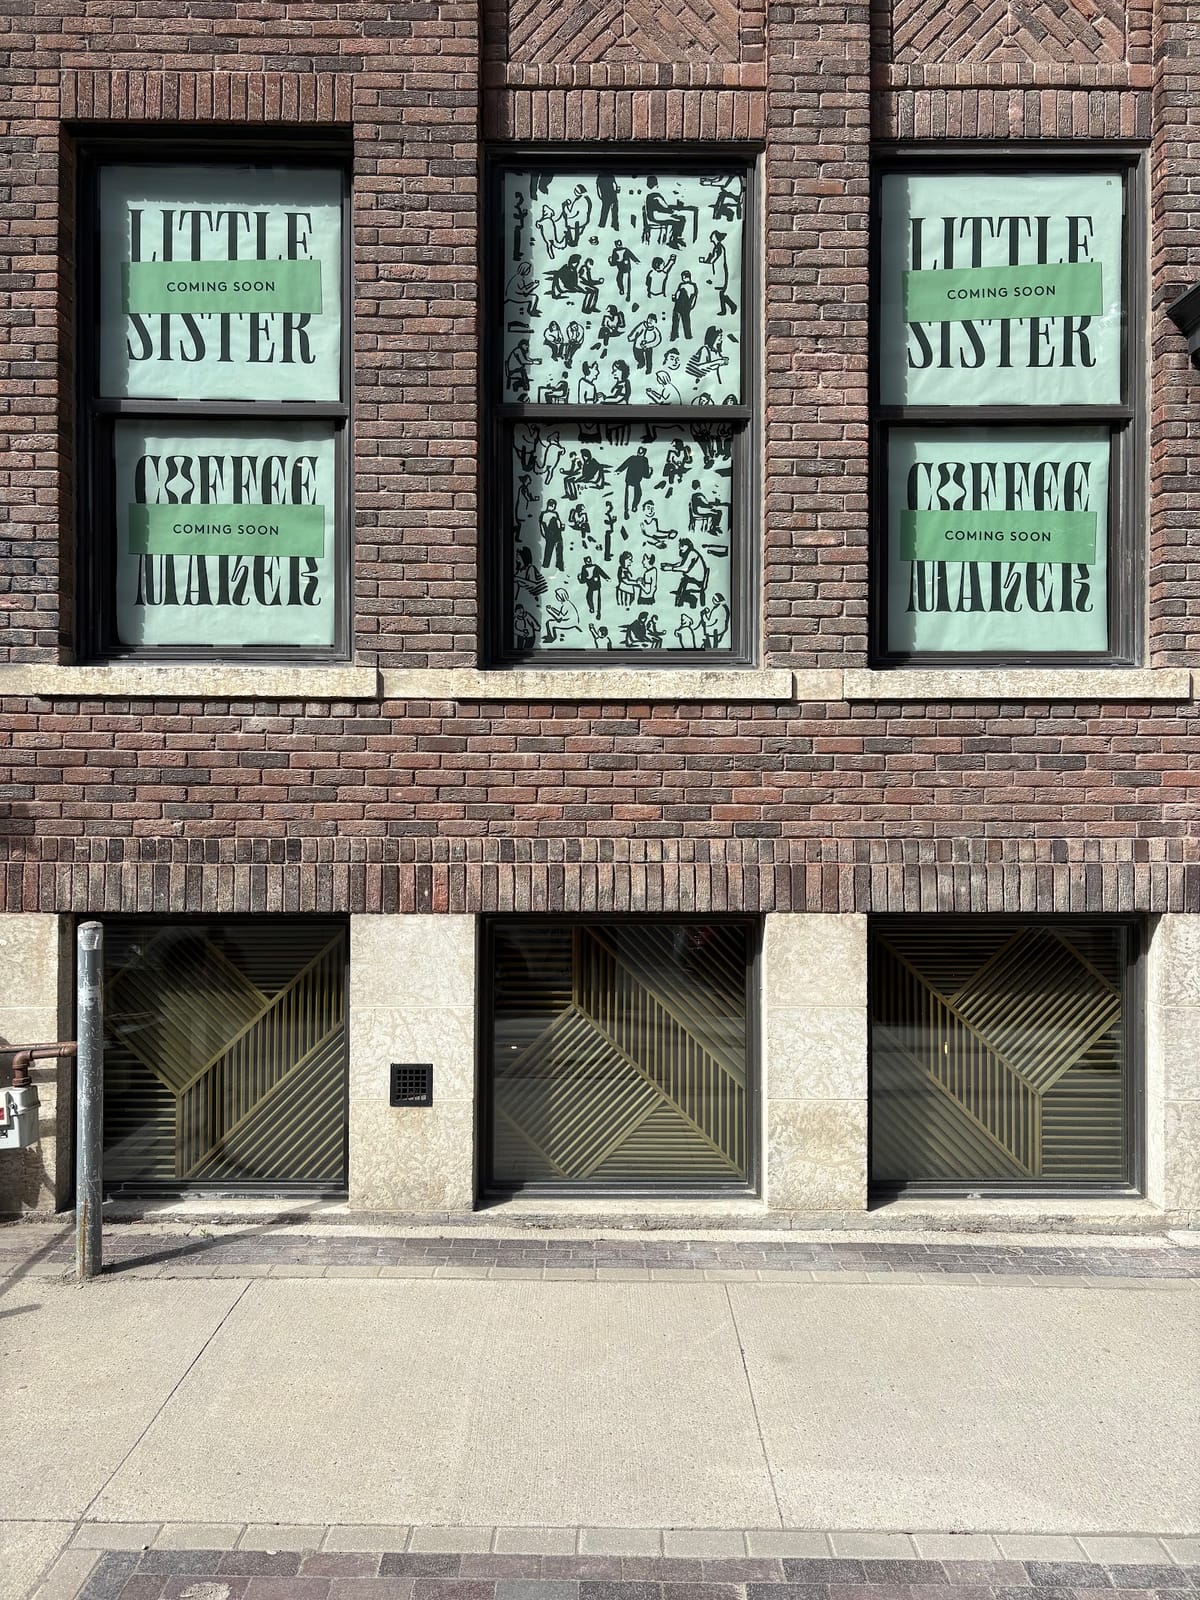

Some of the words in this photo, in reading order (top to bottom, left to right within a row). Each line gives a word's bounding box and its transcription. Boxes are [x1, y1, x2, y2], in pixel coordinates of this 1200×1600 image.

[128, 209, 313, 262] LITTLE
[909, 216, 1094, 271] LITTLE
[166, 281, 228, 292] COMING
[233, 281, 276, 292] SOON
[947, 287, 1008, 300] COMING
[1014, 285, 1056, 297] SOON
[127, 312, 316, 364] SISTER
[907, 315, 1097, 369] SISTER
[134, 454, 319, 505] COFFEE
[907, 461, 1092, 512] COFFEE
[173, 524, 232, 534] COMING
[237, 525, 279, 535] SOON
[945, 530, 1005, 541] COMING
[1010, 531, 1051, 542] SOON
[134, 553, 322, 606] MAKER
[904, 560, 1094, 613] MAKER
